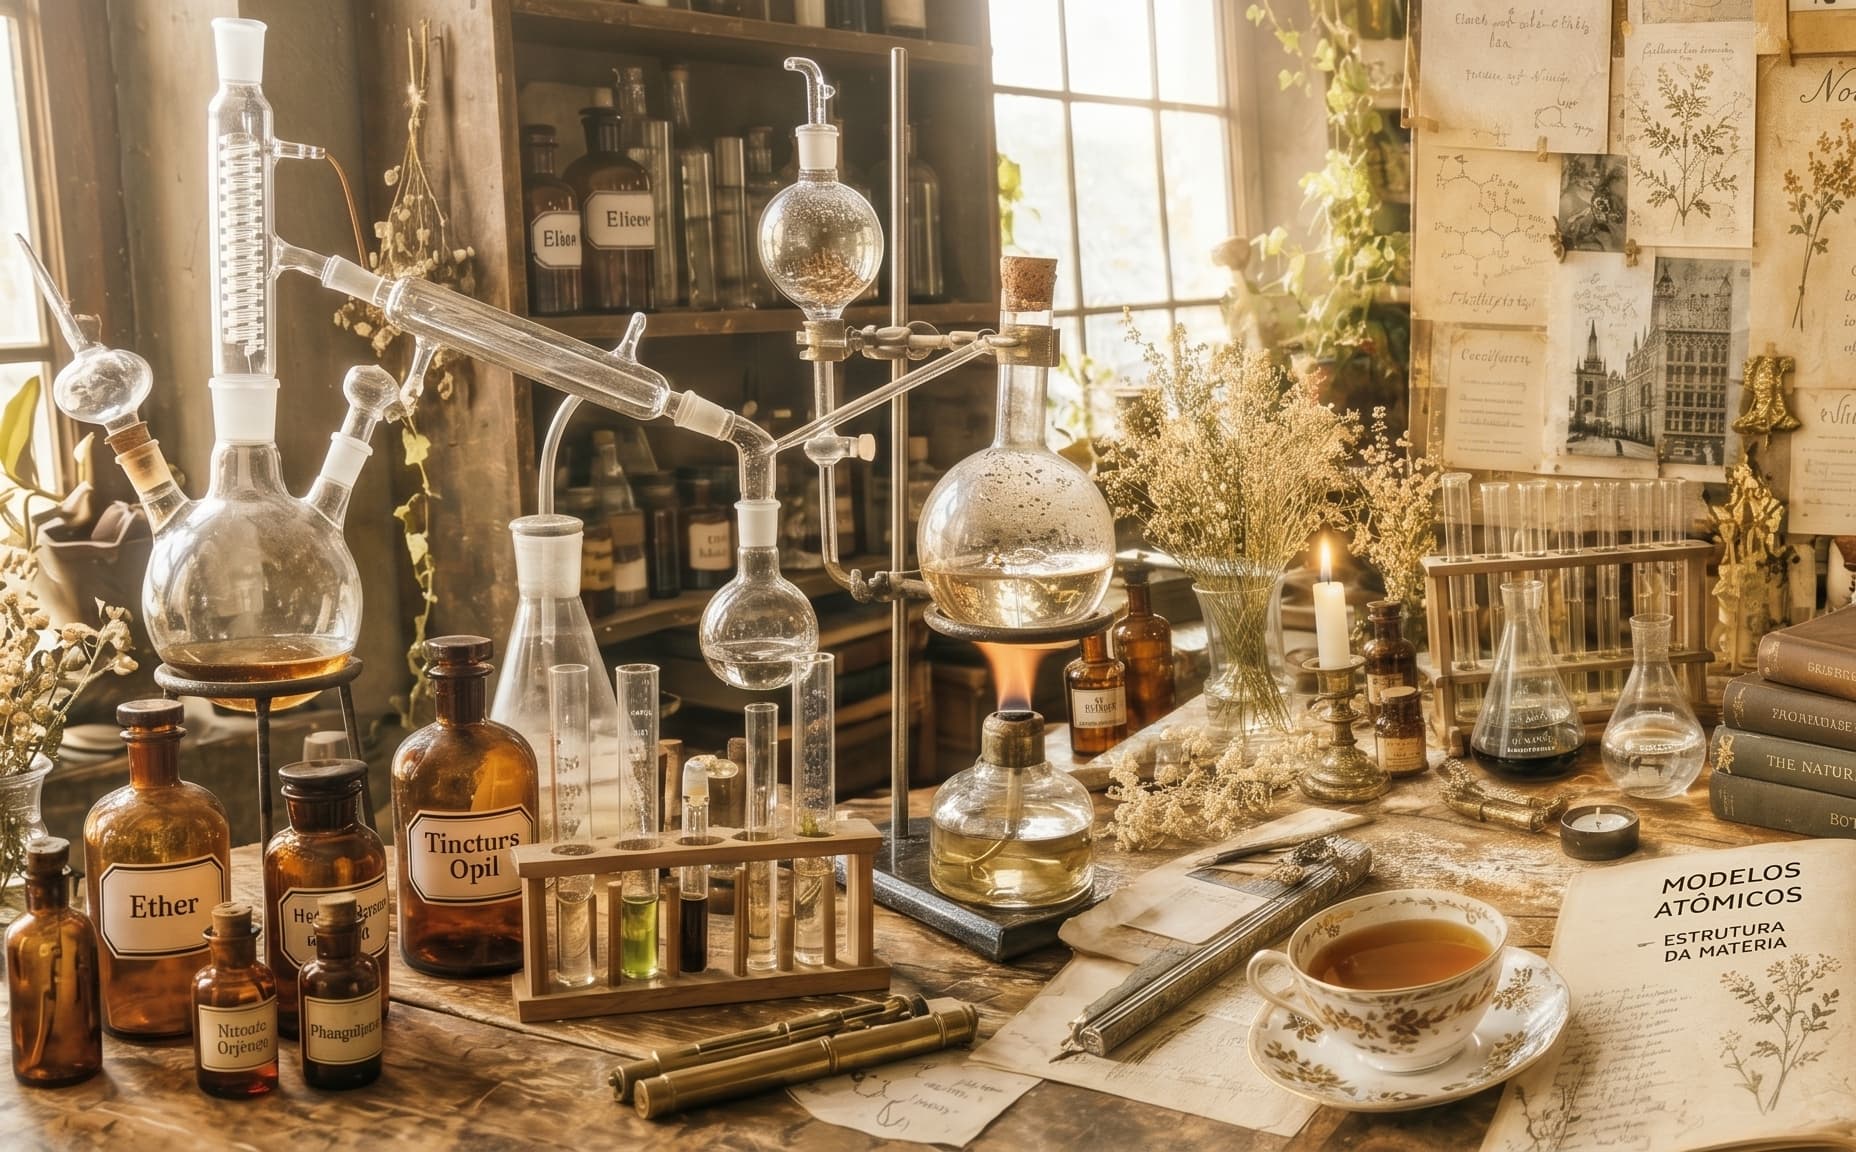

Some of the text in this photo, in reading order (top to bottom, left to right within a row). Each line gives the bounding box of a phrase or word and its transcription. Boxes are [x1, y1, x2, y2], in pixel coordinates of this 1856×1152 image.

[1767, 754, 1796, 771] THE
[424, 832, 520, 854] Tincturs
[450, 855, 500, 884] Opil
[1662, 862, 1801, 894] MODELOS
[129, 895, 199, 918] Ether
[1654, 886, 1803, 918] ATÔMICOS
[1664, 921, 1785, 947] ESTRUTURA
[1664, 937, 1787, 962] DA MATERIA
